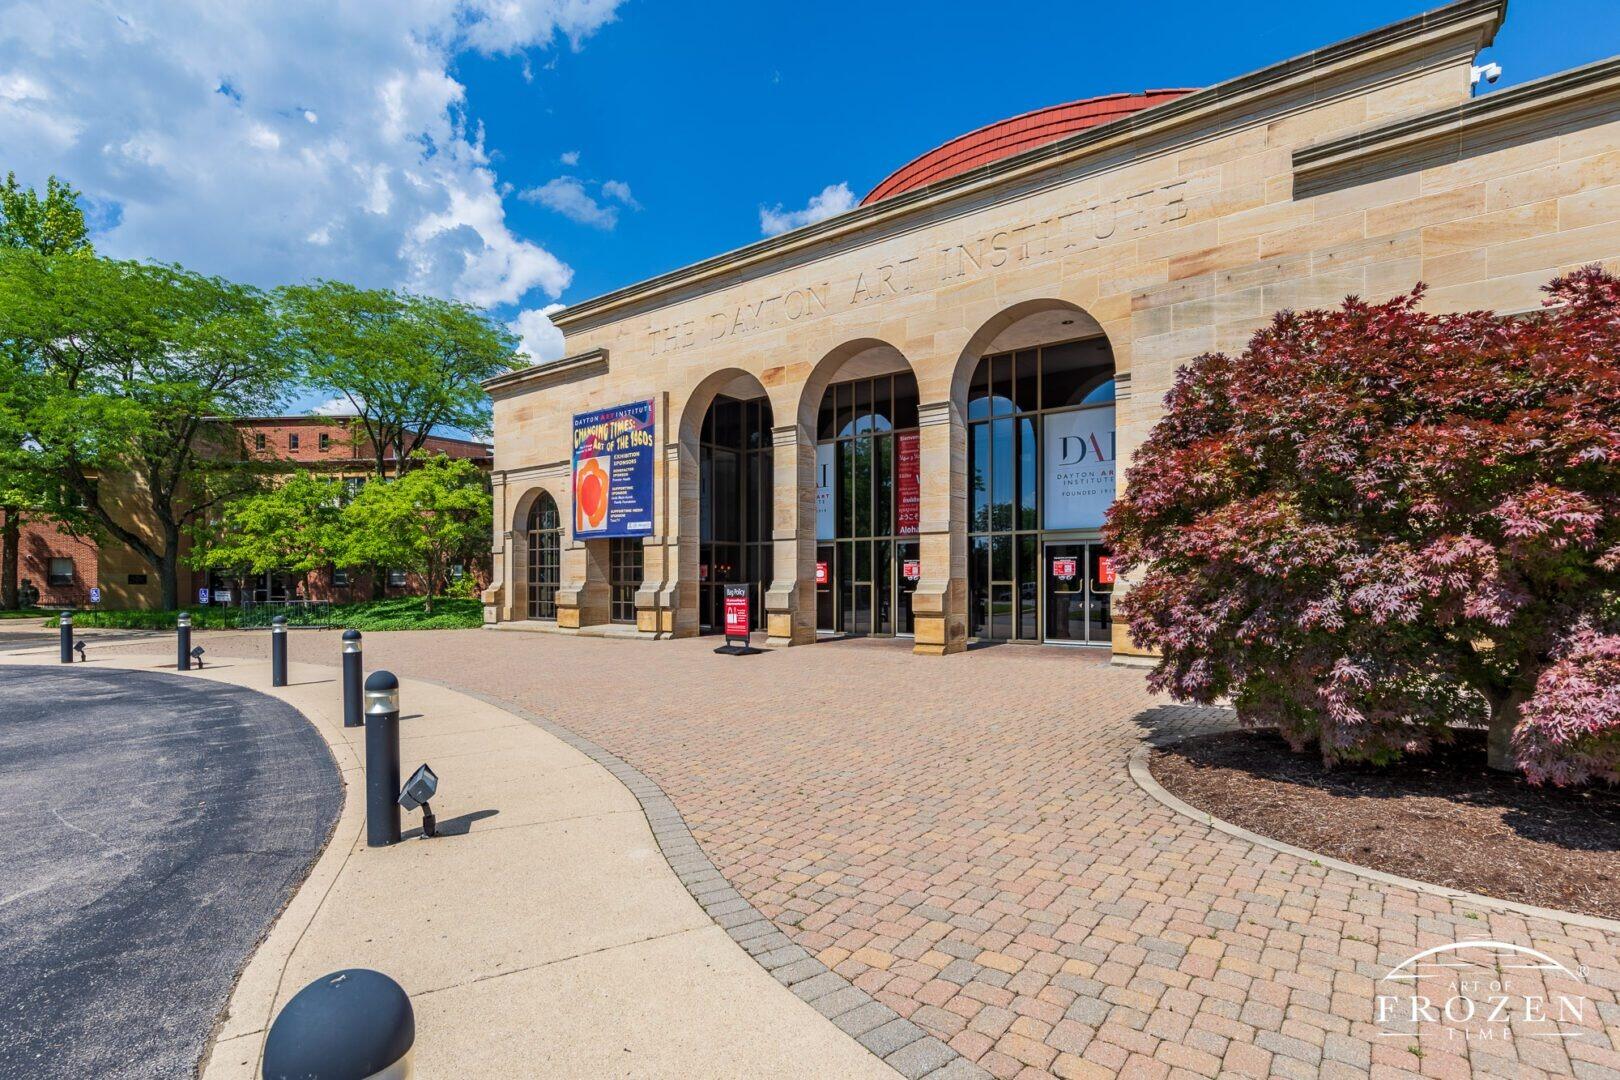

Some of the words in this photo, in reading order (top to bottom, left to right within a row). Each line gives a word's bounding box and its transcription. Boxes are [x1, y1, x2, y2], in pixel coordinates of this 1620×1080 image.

[649, 321, 694, 356] THE
[711, 282, 831, 341] DAYTON
[850, 257, 919, 304] ART
[942, 181, 1188, 281] INSTITUTE
[575, 415, 600, 426] DAYTON
[616, 405, 652, 417] INSTITUTE
[575, 423, 608, 449] CHANGING
[611, 418, 636, 440] TIMES:
[607, 440, 614, 452] OF
[617, 434, 628, 451] THE
[1057, 471, 1095, 480] DAYTON
[1061, 489, 1097, 497] FOUNDED
